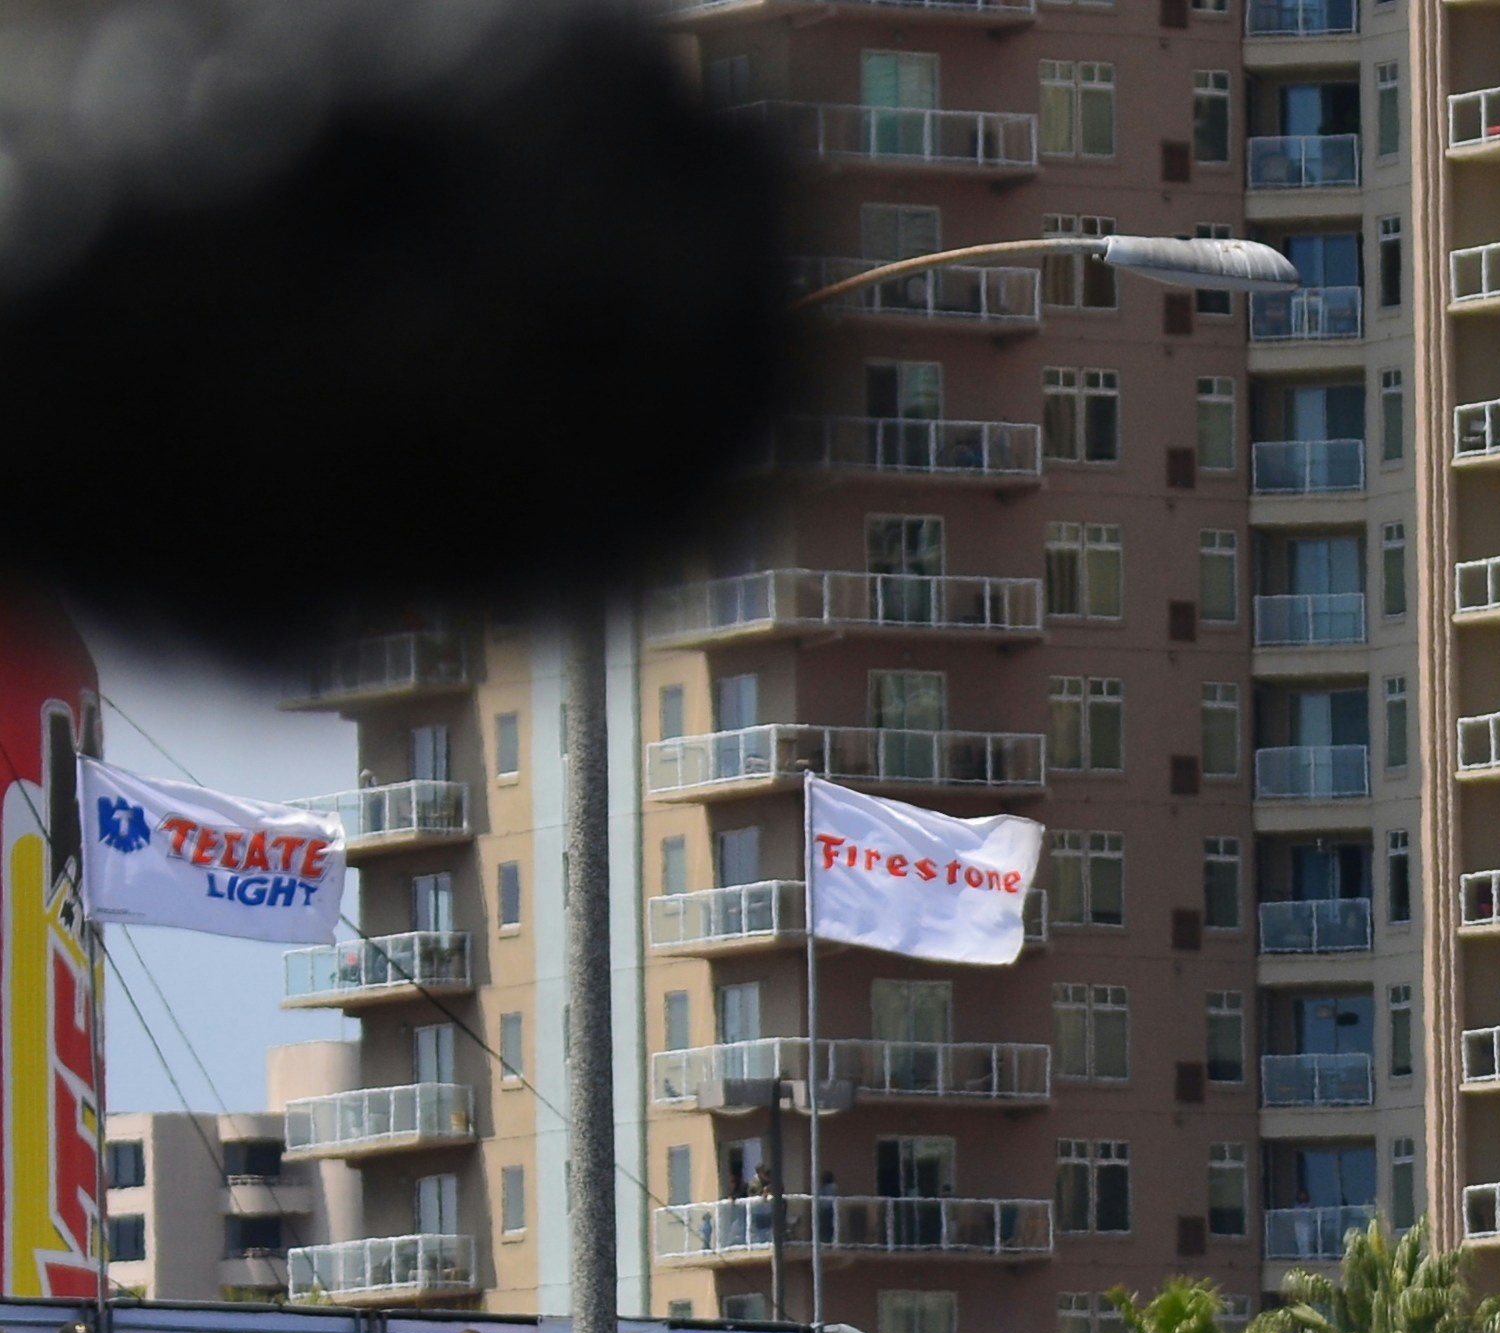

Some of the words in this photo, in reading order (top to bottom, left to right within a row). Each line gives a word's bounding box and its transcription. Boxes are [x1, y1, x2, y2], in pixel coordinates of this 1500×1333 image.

[163, 818, 329, 878] TECATE
[816, 833, 1022, 893] Firestone
[206, 873, 318, 907] LIGHT
